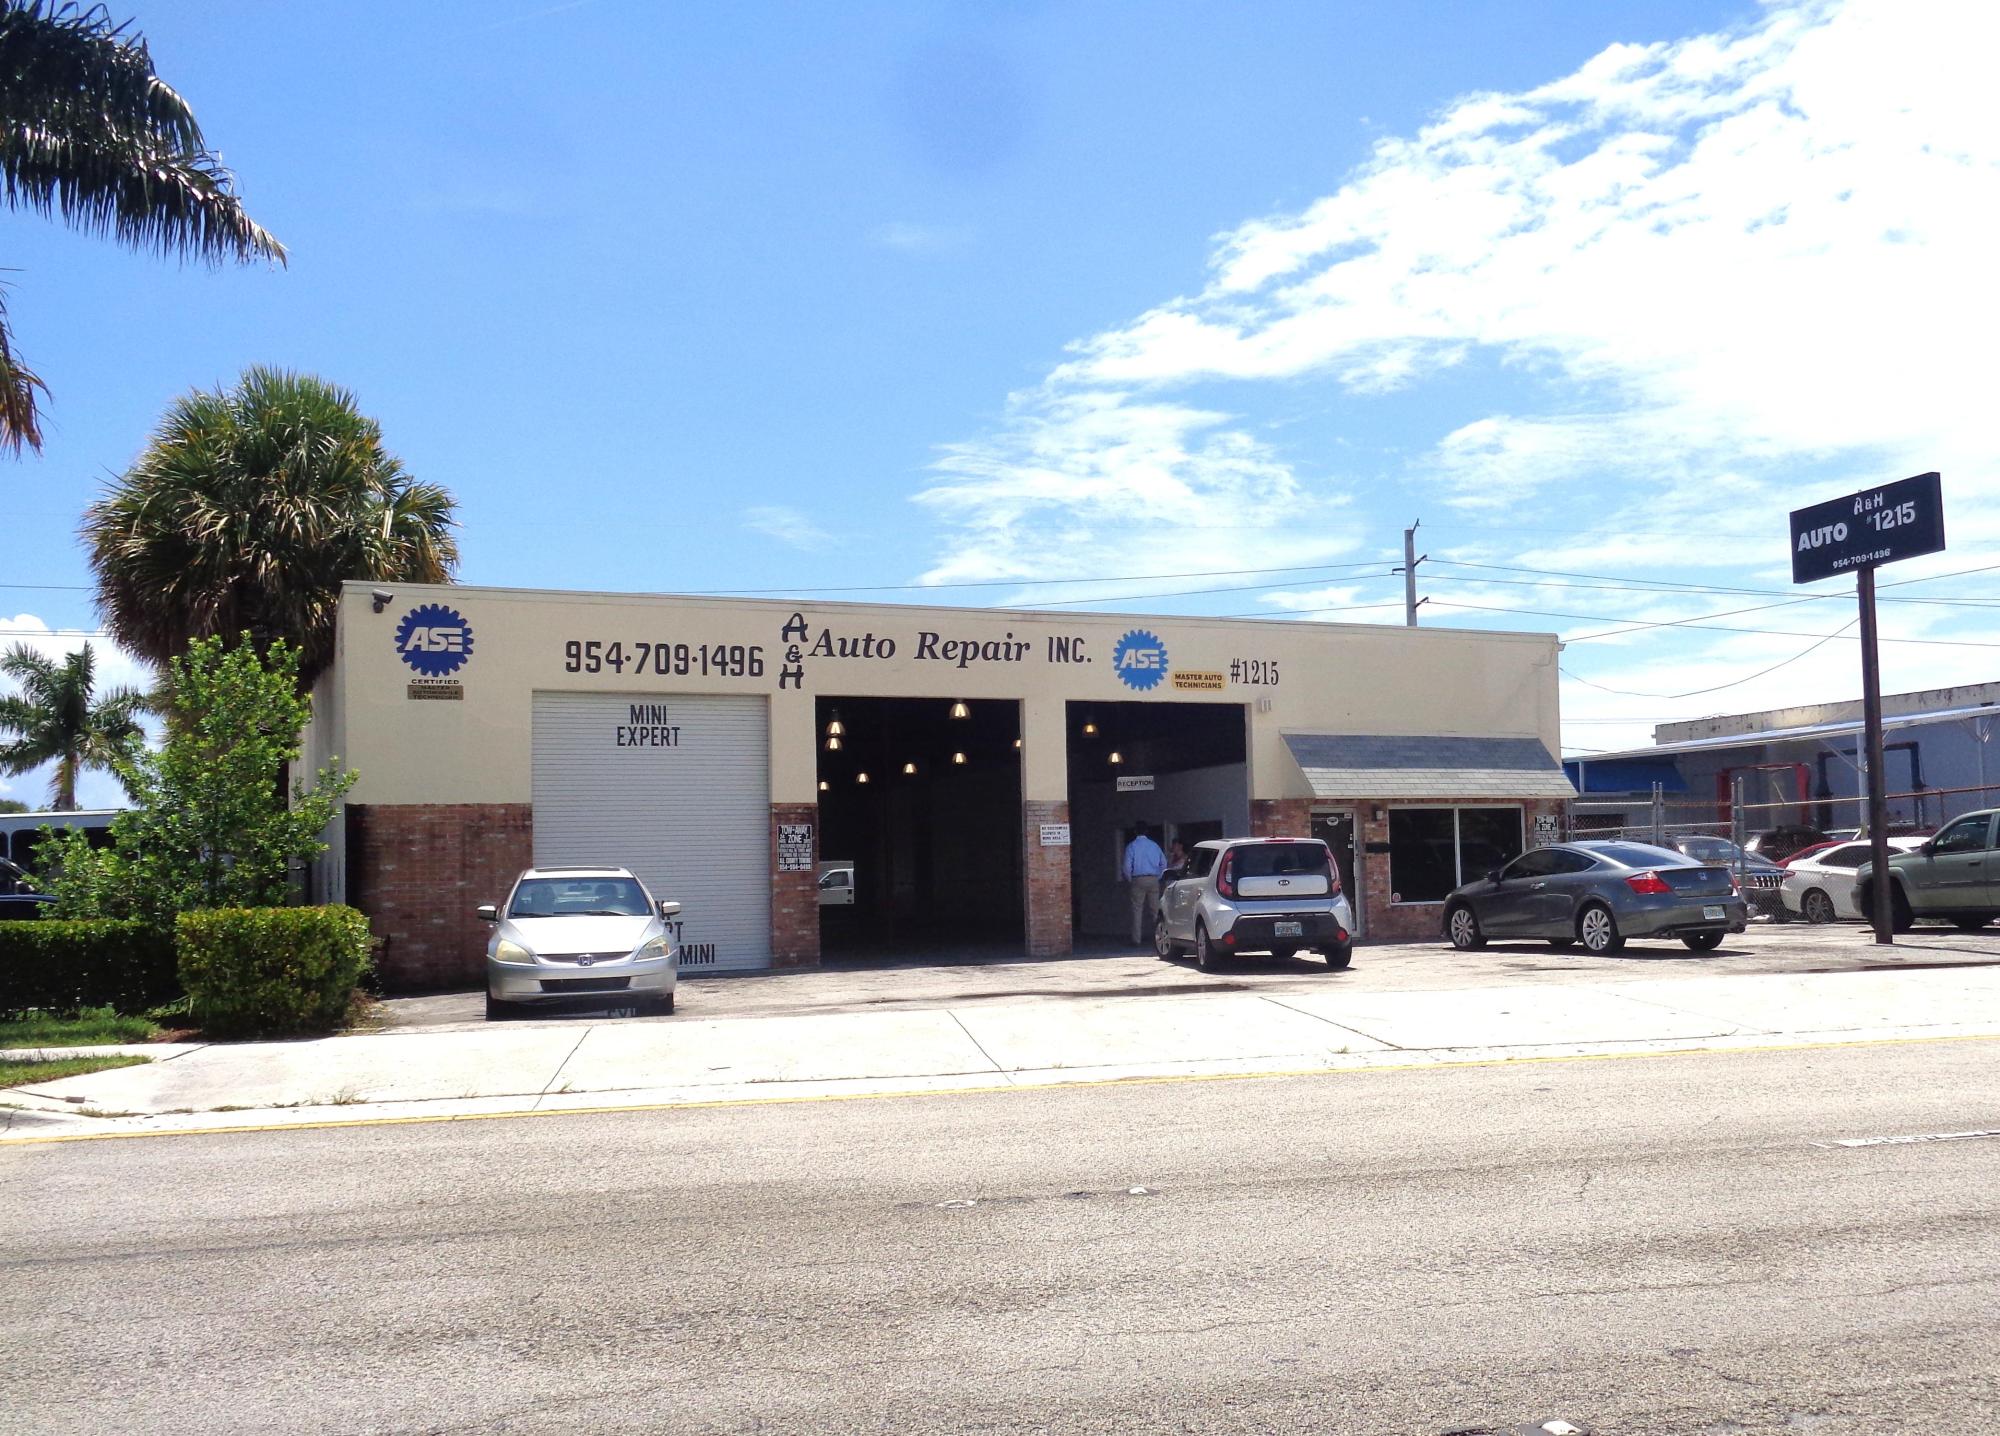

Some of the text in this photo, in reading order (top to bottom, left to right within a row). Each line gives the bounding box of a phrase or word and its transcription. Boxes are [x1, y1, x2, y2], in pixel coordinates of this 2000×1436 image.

[1798, 523, 1848, 552] AUTO
[404, 627, 463, 652] ASE
[808, 628, 1093, 669] Auto Repair INC.
[1120, 649, 1160, 669] ASE
[1175, 673, 1202, 681] MASTER
[1230, 657, 1279, 686] #1215
[1176, 681, 1222, 689] TECHNICIANS
[630, 704, 667, 725] MINI
[617, 726, 681, 747] EXPERT
[788, 835, 802, 843] ZONE
[679, 944, 715, 965] MINI
